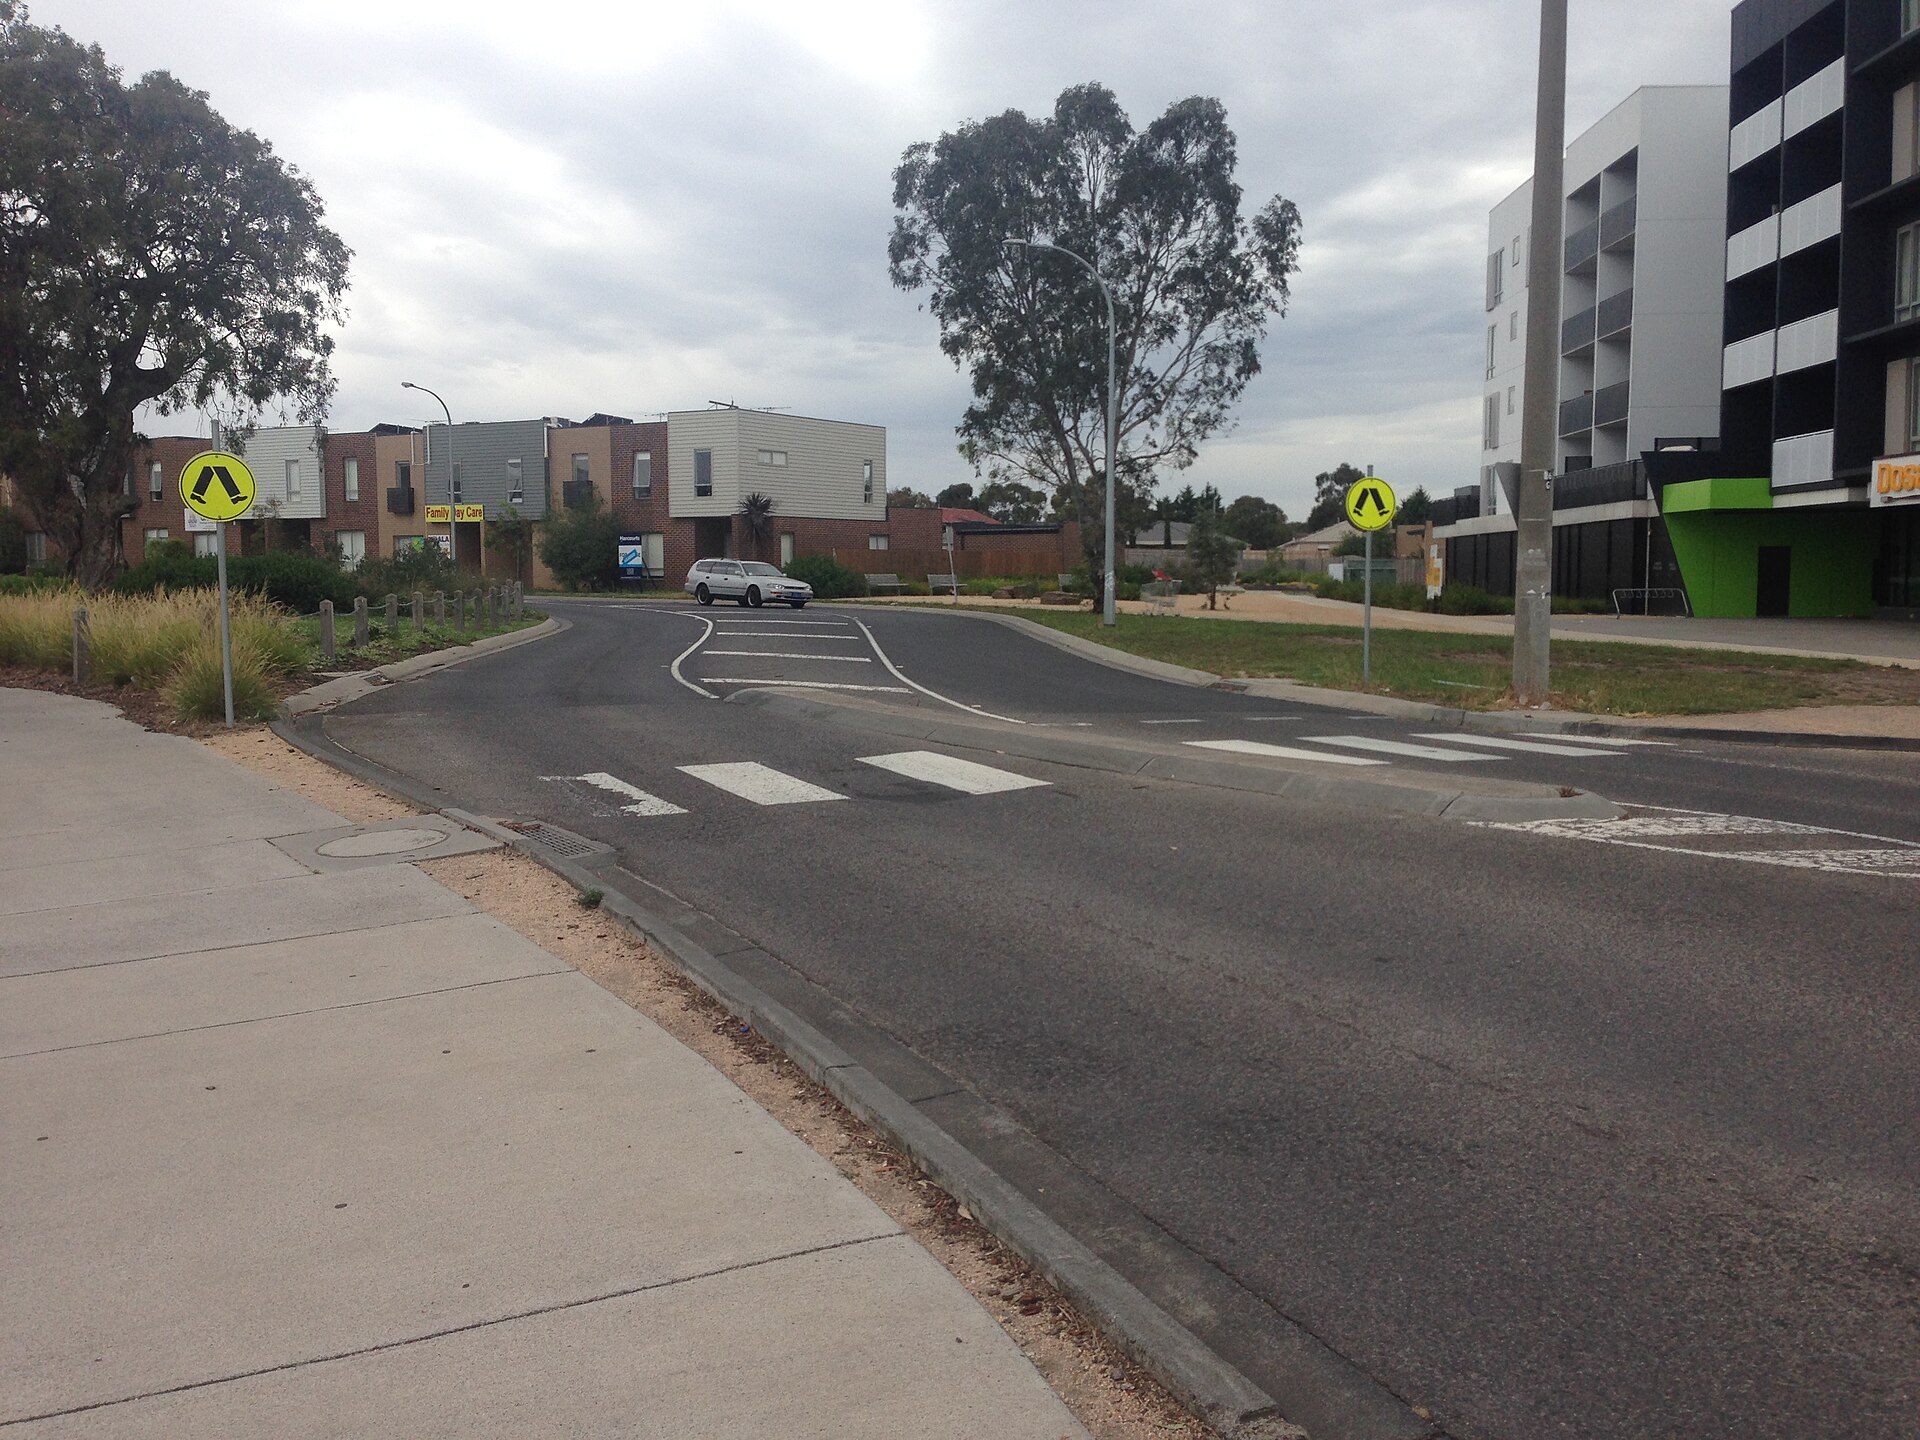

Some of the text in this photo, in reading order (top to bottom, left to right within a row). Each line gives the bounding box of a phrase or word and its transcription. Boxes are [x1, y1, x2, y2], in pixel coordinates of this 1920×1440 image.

[426, 506, 482, 520] Family ay Care
